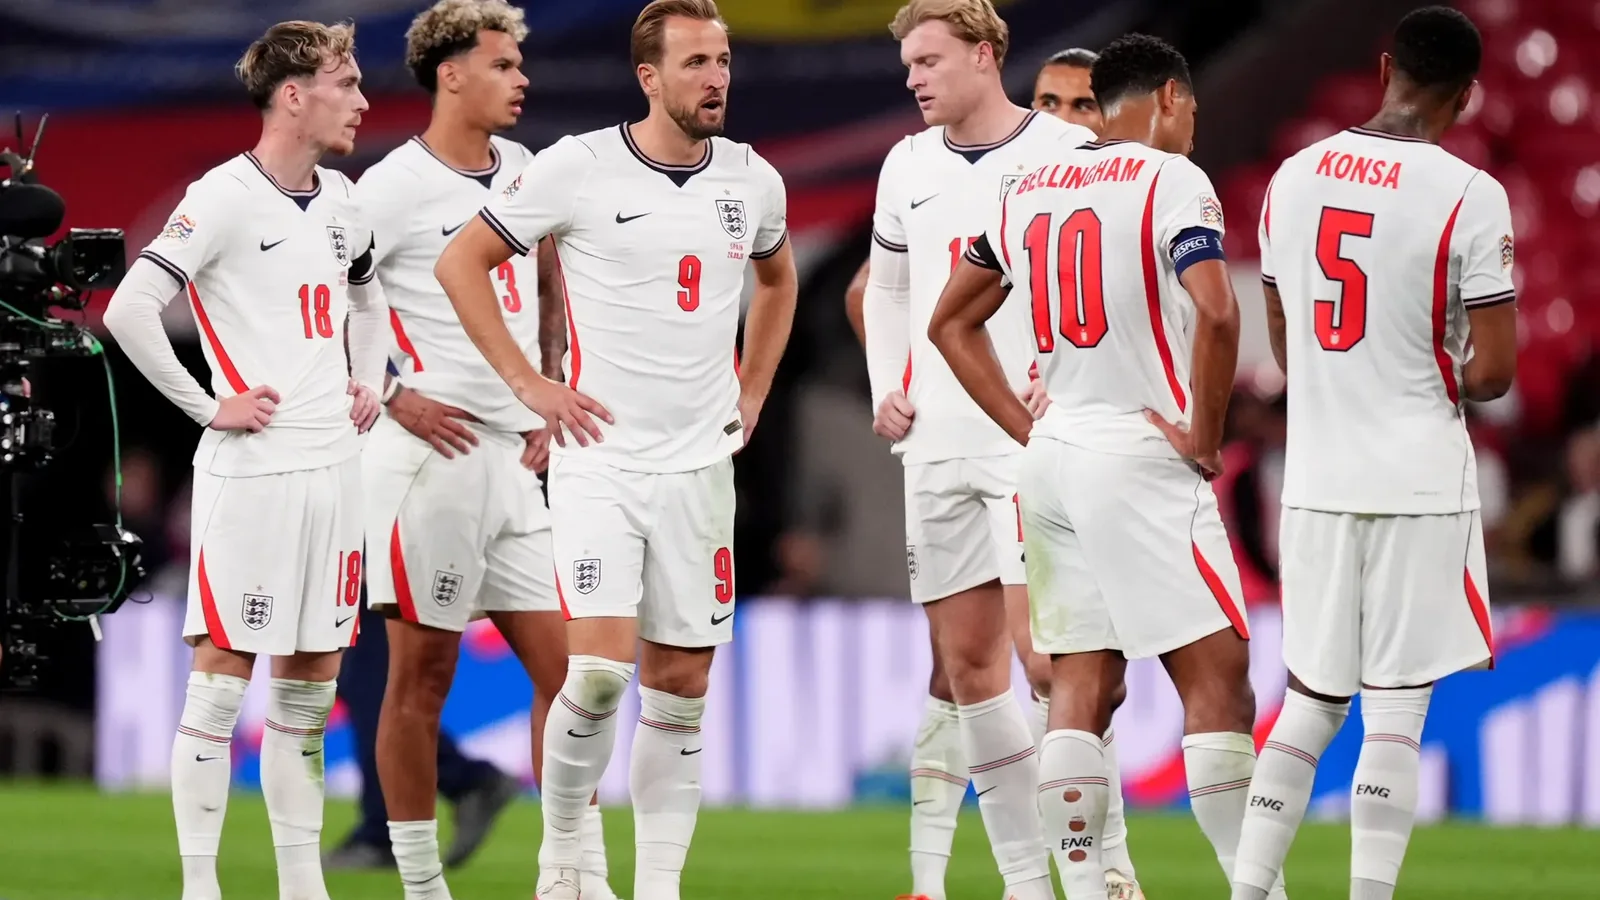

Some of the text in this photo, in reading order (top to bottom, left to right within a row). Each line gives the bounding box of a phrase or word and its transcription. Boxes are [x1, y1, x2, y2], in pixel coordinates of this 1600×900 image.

[1016, 157, 1146, 195] BELLINGHAM
[1316, 150, 1402, 189] KONSA
[1173, 238, 1208, 260] RESPECT
[677, 254, 702, 312] 9
[1023, 206, 1108, 353] 10
[1314, 206, 1375, 352] 5
[298, 283, 334, 339] 18
[336, 550, 361, 607] 18
[714, 547, 733, 604] 9
[1250, 795, 1285, 812] ENG
[1356, 784, 1391, 799] ENG
[1061, 836, 1094, 850] ENG
